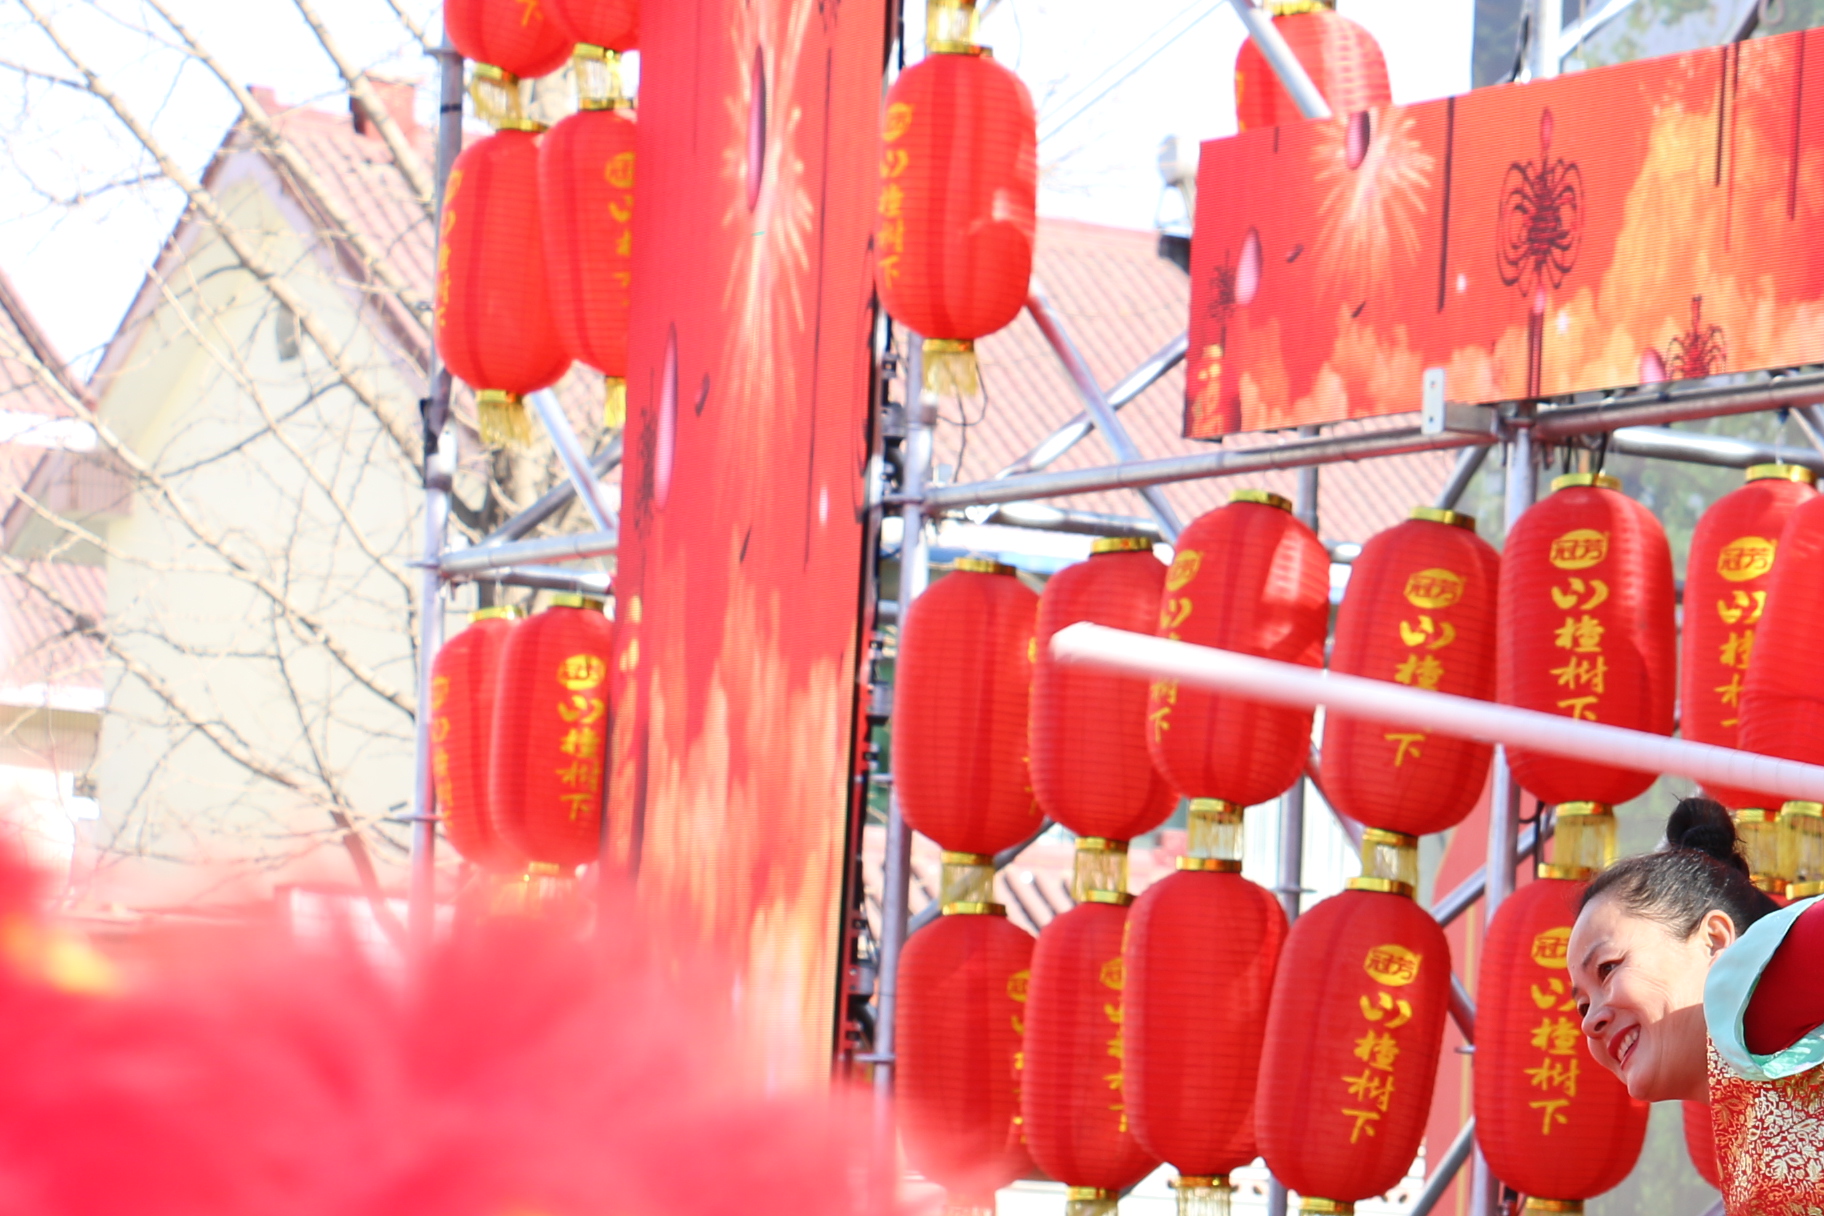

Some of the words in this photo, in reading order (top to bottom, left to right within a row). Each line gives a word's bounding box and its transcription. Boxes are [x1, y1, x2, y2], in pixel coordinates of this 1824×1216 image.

[1384, 614, 1457, 768] 山楂下
[1550, 577, 1609, 722] 山楂树下
[555, 694, 606, 822] 山楂树下
[1340, 991, 1414, 1145] 山楂树下
[1522, 976, 1582, 1136] 山楂树下
